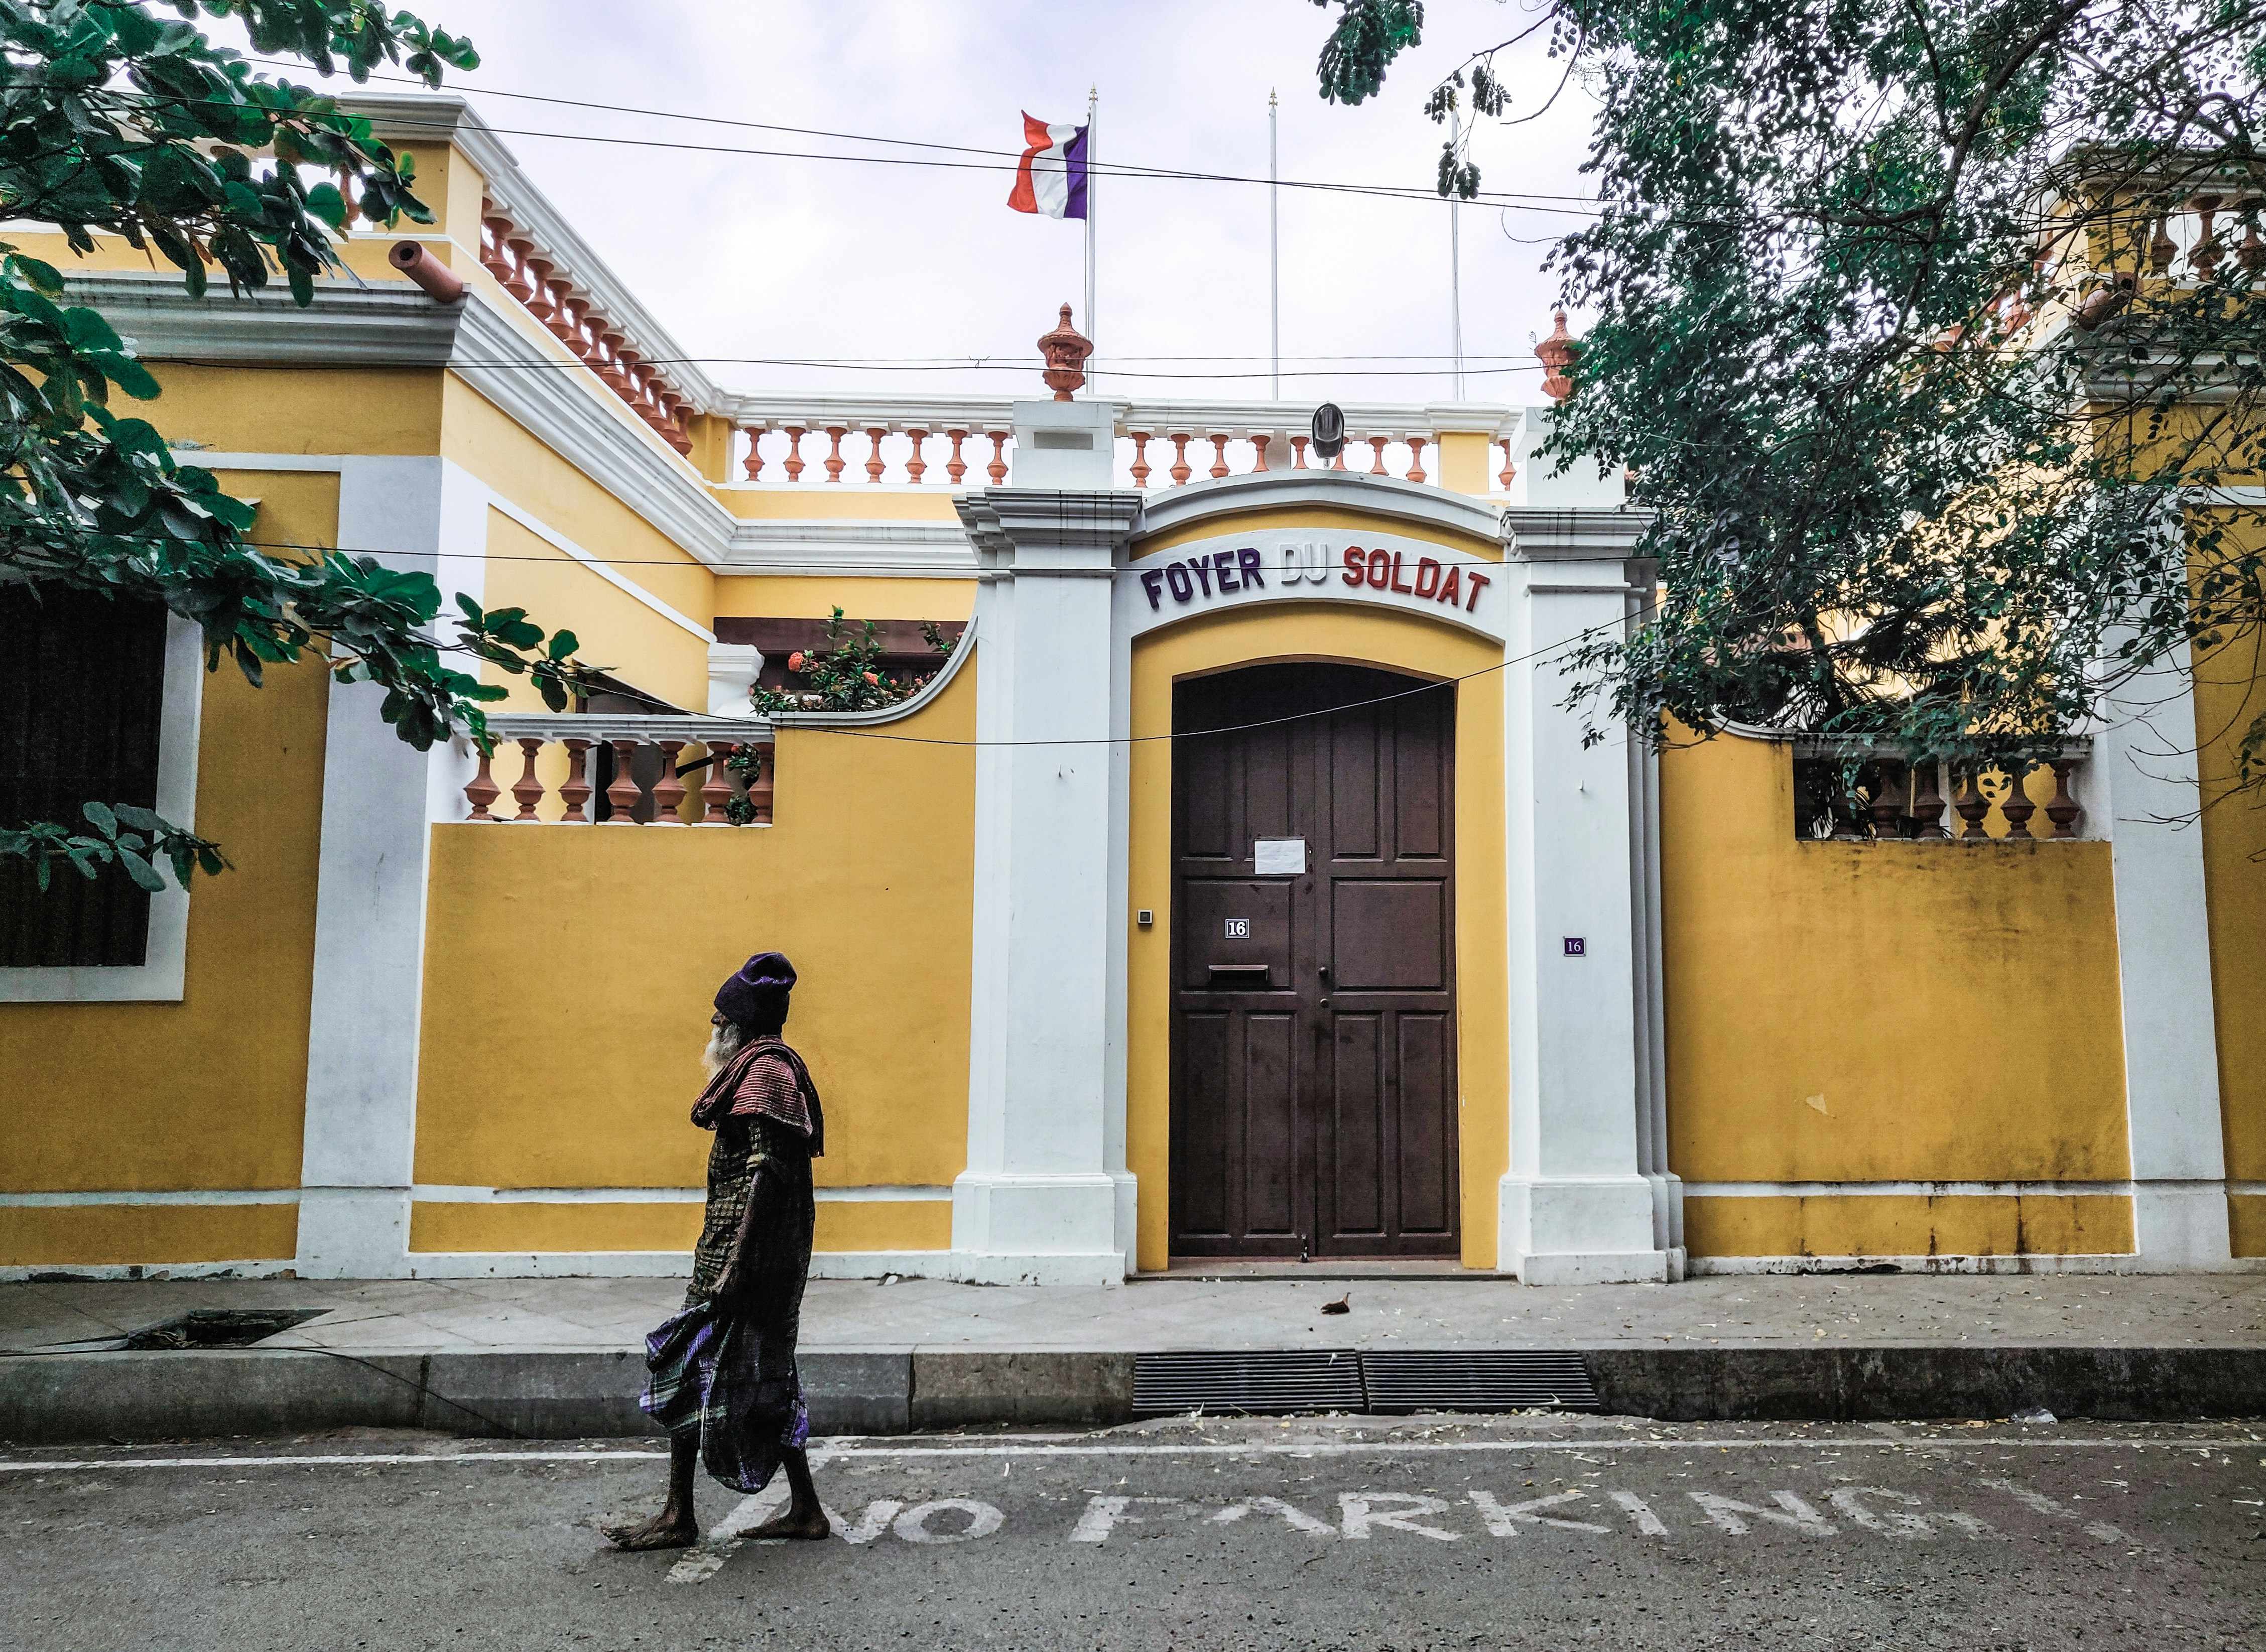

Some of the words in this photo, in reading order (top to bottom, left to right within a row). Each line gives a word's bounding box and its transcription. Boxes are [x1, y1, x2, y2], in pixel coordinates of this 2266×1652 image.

[1140, 547, 1265, 610] FOYER
[1280, 543, 1327, 584] DU
[1341, 545, 1491, 612] SOLDAT
[1228, 922, 1246, 936] 16
[1568, 941, 1581, 952] 16
